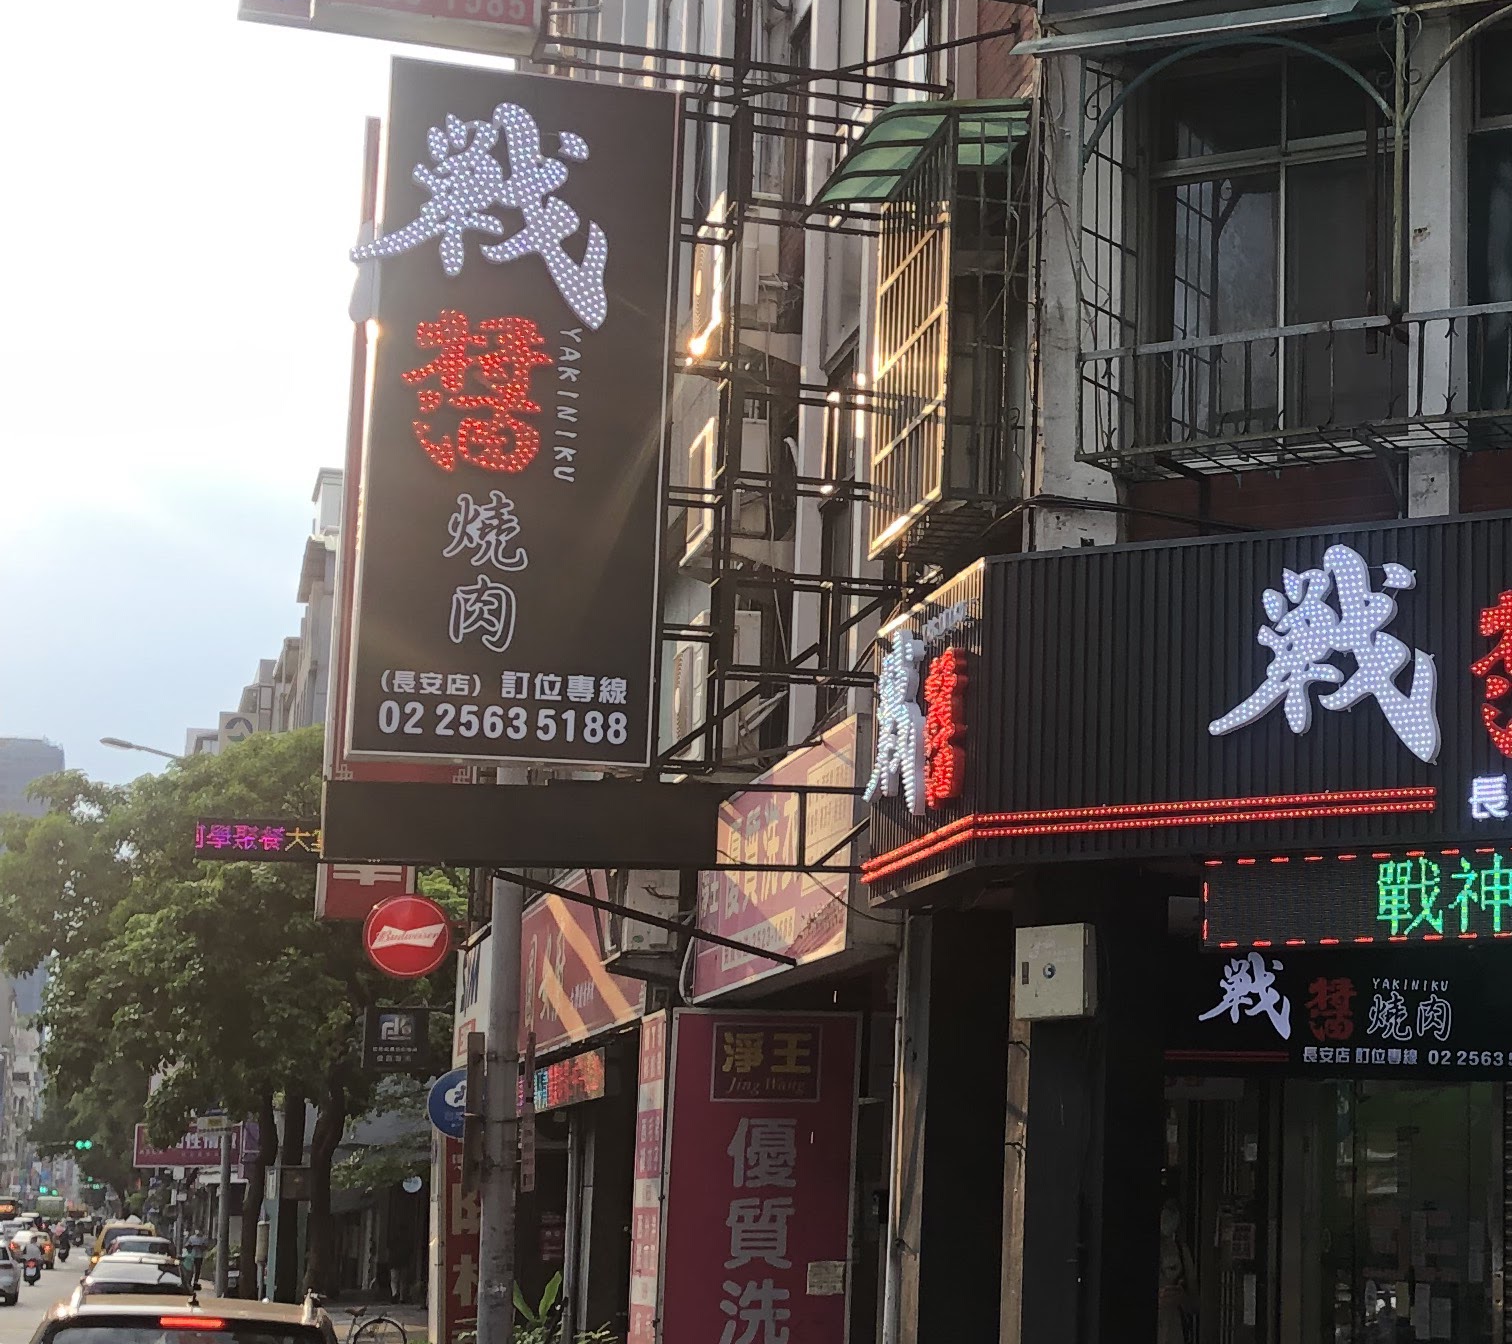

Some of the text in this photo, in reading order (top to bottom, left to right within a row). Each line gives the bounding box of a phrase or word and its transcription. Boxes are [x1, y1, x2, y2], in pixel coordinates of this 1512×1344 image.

[552, 327, 579, 484] YAKINIKU
[502, 670, 628, 706] 訂位專線
[378, 700, 424, 736] 02
[376, 924, 441, 943] Budweiser
[1372, 977, 1450, 992] YAKINIKU
[1302, 1046, 1350, 1064] 長安店
[1428, 1051, 1451, 1066] 02
